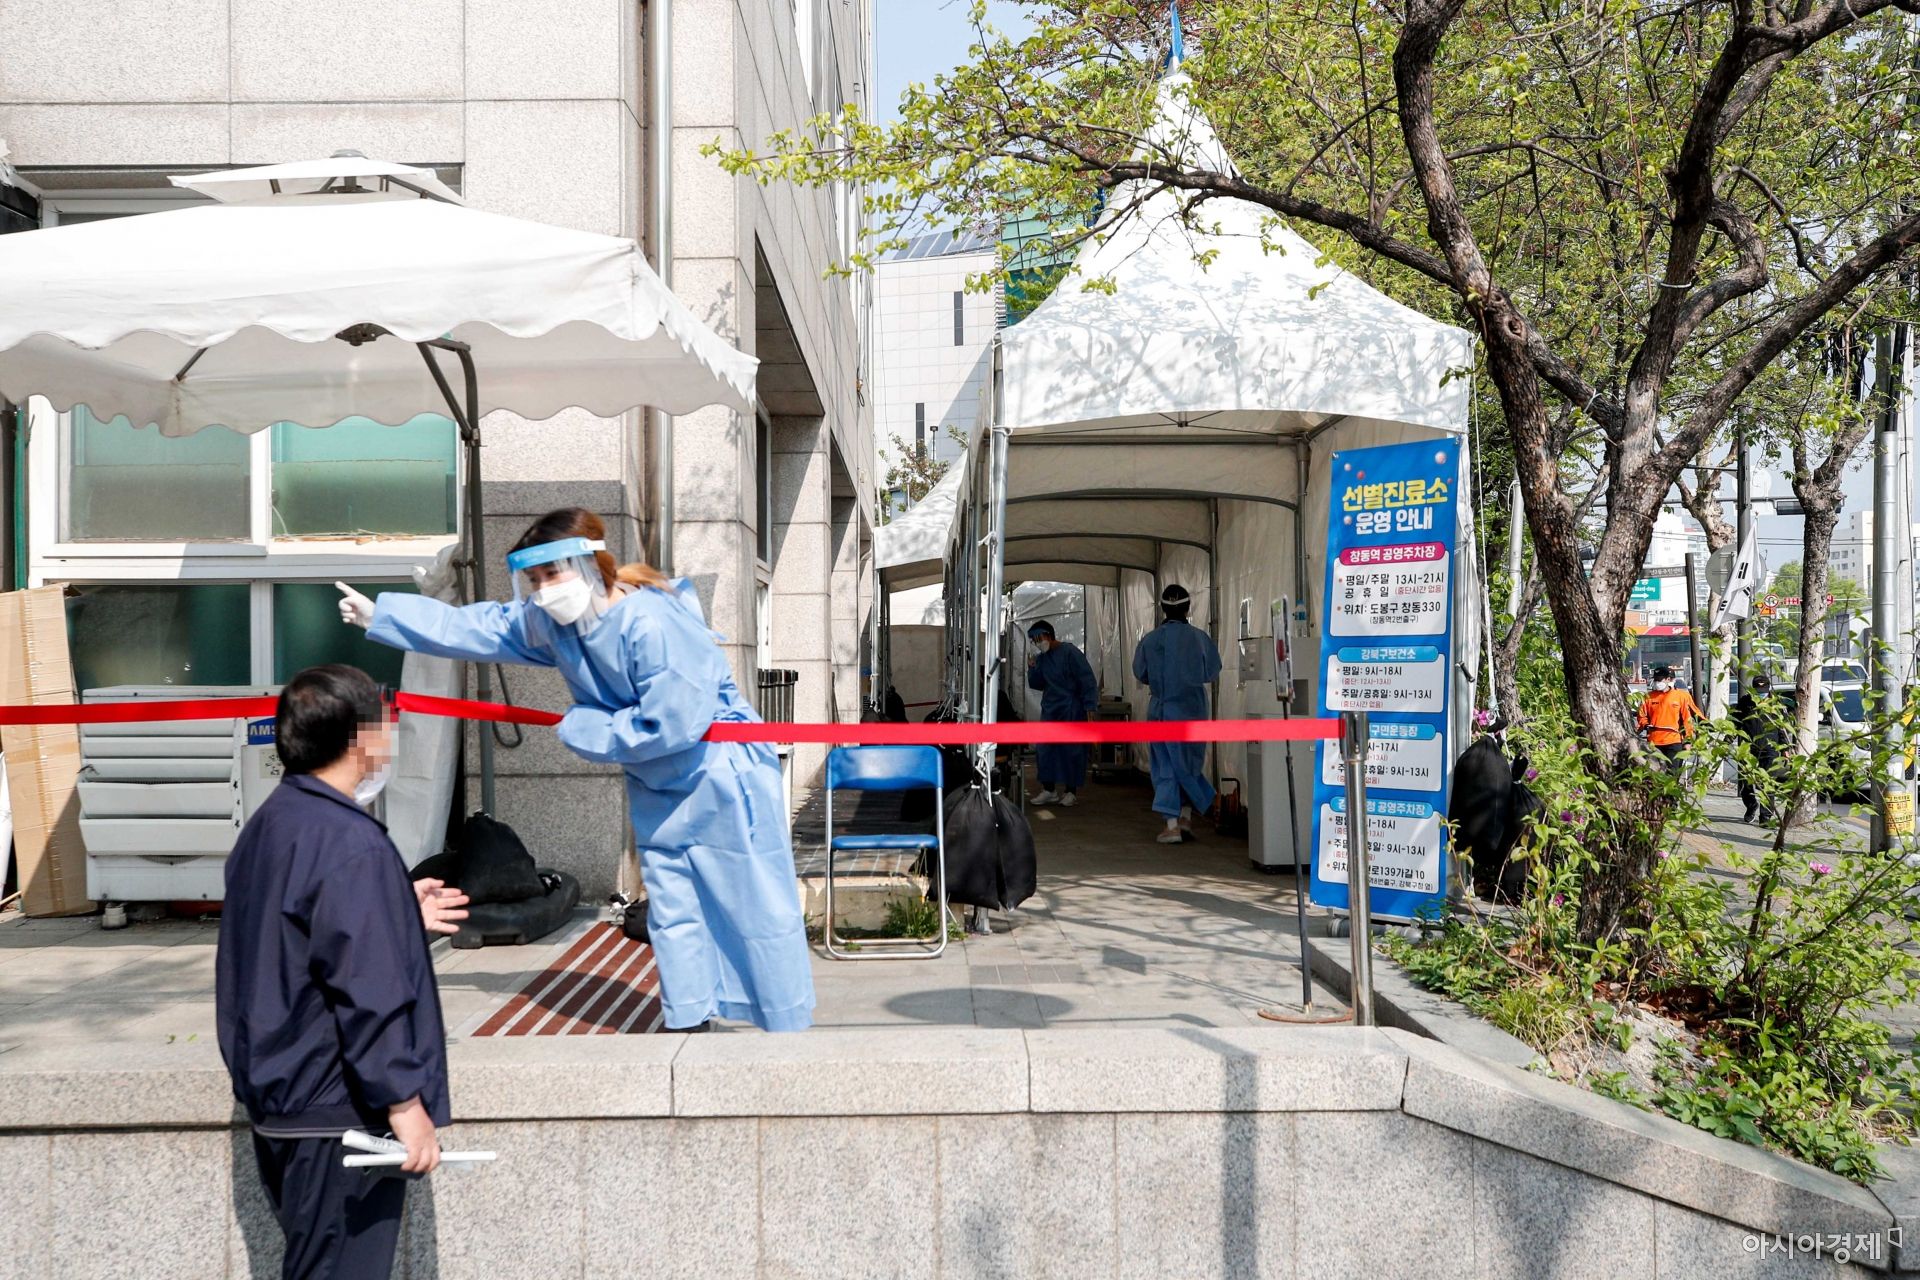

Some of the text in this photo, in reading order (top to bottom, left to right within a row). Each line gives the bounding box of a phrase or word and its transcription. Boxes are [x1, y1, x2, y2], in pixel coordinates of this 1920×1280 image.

[1342, 477, 1448, 512] 선별진료소
[1356, 506, 1433, 535] 운영 안내
[1350, 545, 1436, 563] 창동역 공영주차장
[1346, 573, 1390, 587] 평일/주말
[1344, 601, 1441, 615] 위치: 도봉구 창동330
[1369, 614, 1419, 624] (창동역2번출구)
[1361, 648, 1416, 660] 강북구보건소
[1342, 666, 1402, 676] 평일: 9시-18시
[1341, 688, 1432, 699] 주말/공휴일: 9시-13시
[1369, 724, 1418, 737] 구민운동장
[1390, 766, 1429, 777] 9시-13시
[1377, 801, 1426, 815] 공영주차장
[1387, 844, 1426, 856] 9시-13시
[1368, 865, 1413, 879] 로139가길
[1415, 870, 1425, 880] 10
